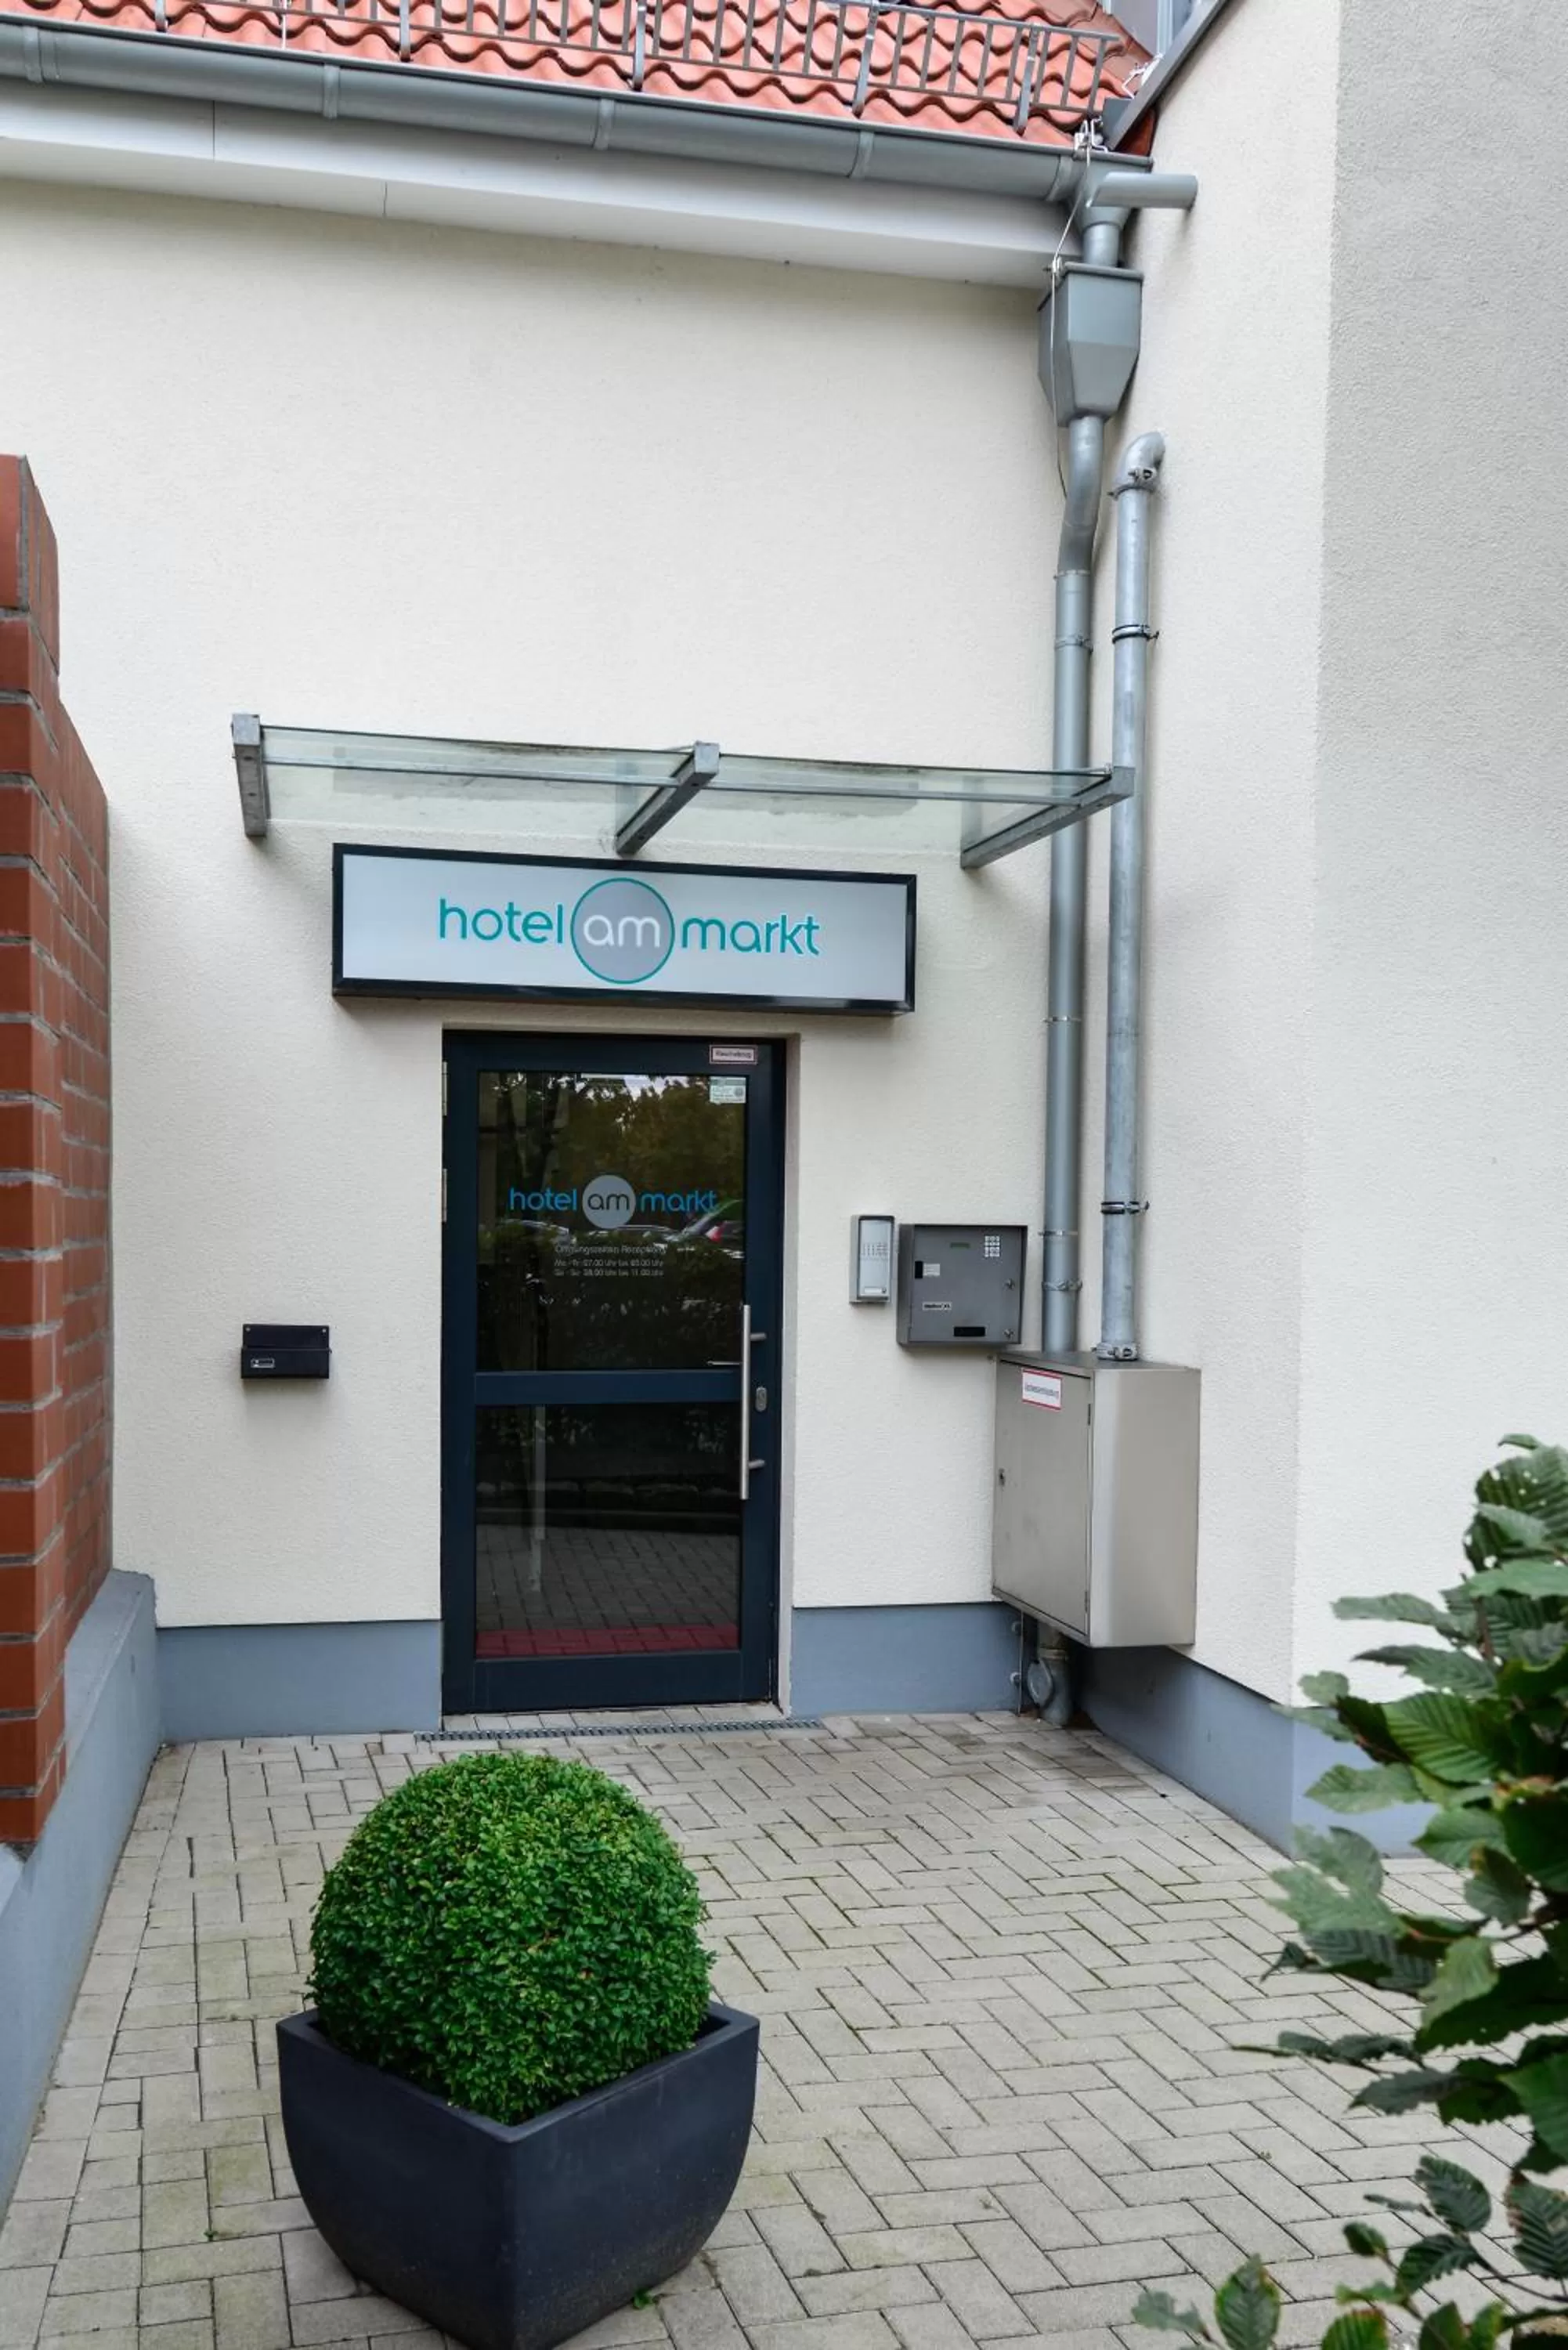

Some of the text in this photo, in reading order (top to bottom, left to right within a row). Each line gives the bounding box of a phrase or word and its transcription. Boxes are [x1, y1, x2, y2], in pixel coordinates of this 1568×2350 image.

[439, 898, 820, 956] hotel am markt
[510, 1188, 717, 1212] hotel am markt
